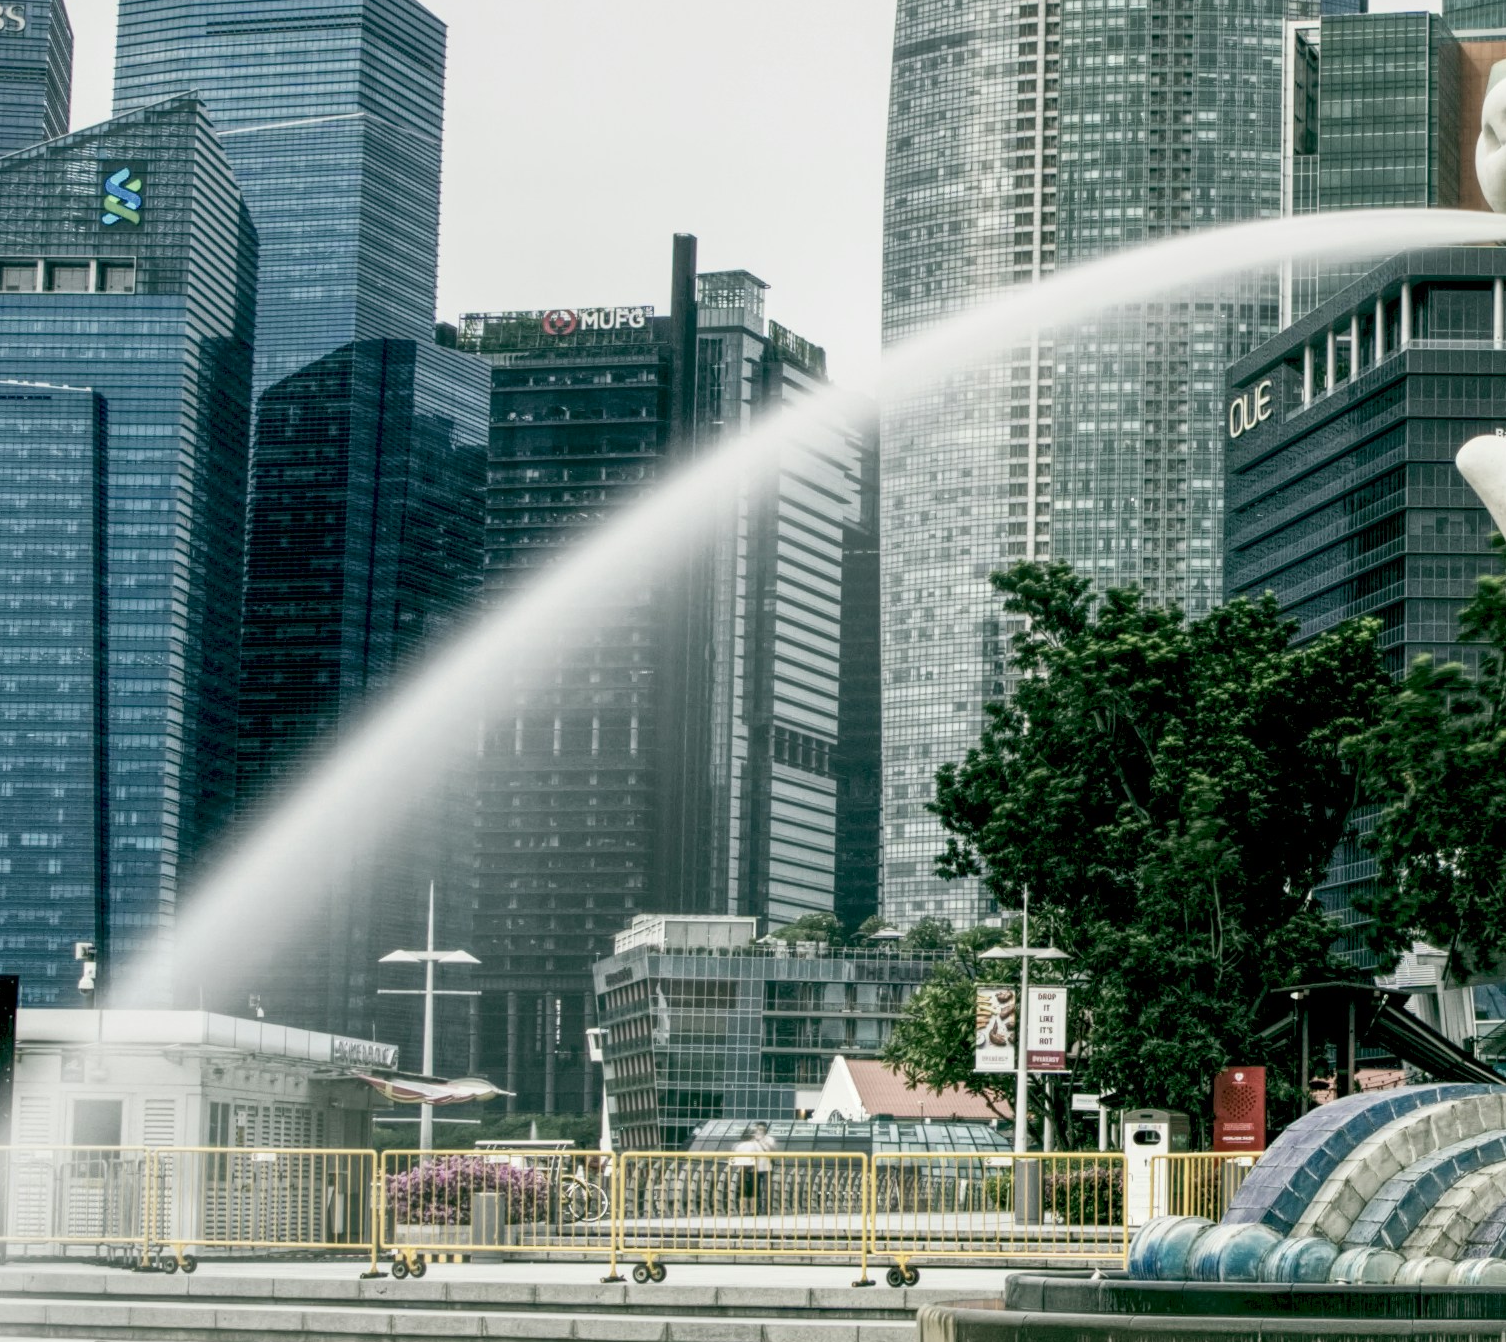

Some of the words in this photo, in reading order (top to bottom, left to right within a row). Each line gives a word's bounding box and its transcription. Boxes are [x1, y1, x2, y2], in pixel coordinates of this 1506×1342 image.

[580, 308, 645, 330] MUFG
[1230, 380, 1272, 438] OUE
[1037, 992, 1057, 1001] DROP
[1043, 1004, 1051, 1012] IT
[1039, 1015, 1055, 1023] LIKE
